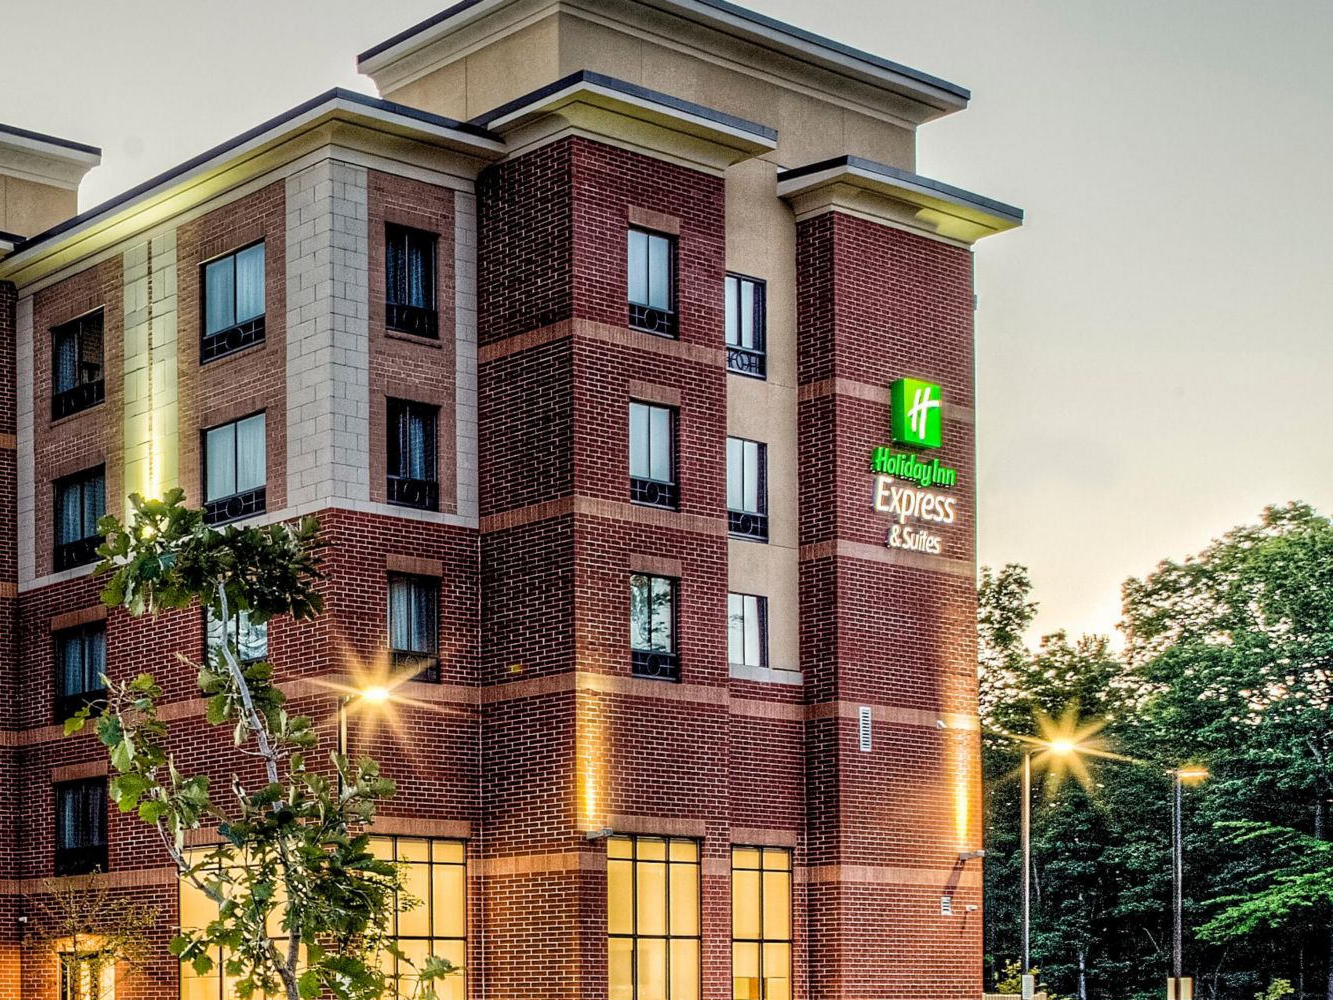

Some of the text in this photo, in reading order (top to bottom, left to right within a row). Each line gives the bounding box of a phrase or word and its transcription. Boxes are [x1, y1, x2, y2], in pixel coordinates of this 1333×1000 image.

[874, 446, 956, 487] Holiday Inn
[875, 475, 956, 524] Express
[889, 525, 941, 554] & Suites
